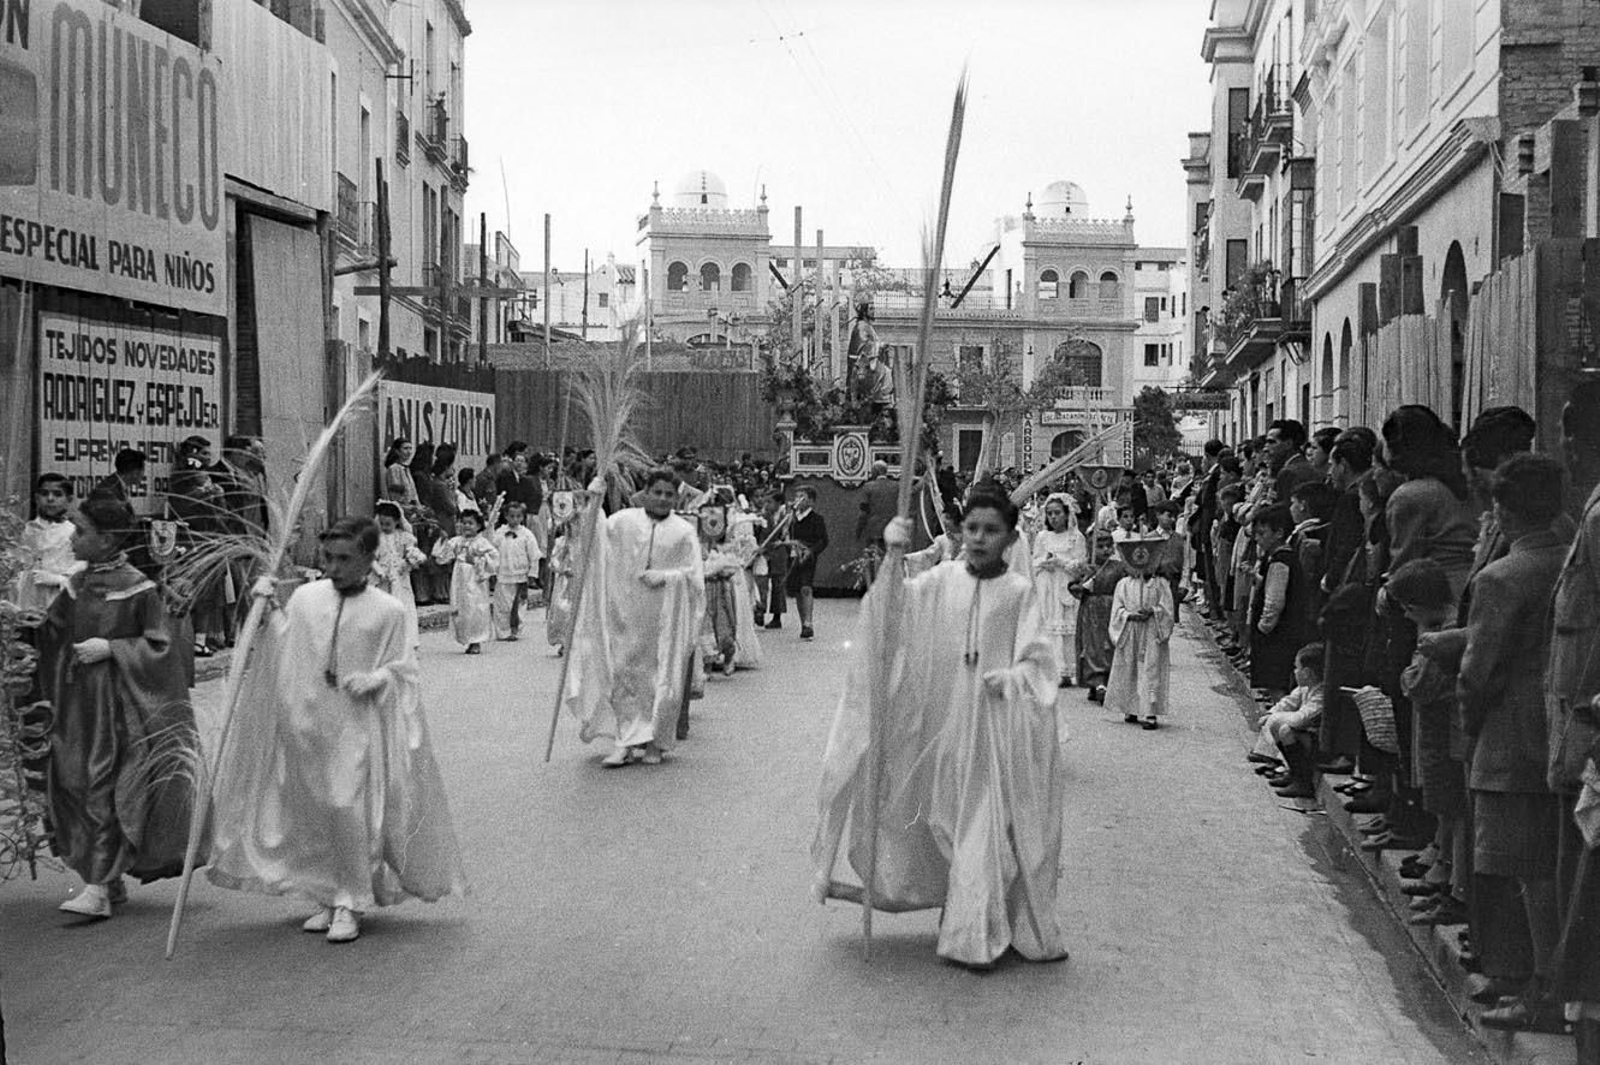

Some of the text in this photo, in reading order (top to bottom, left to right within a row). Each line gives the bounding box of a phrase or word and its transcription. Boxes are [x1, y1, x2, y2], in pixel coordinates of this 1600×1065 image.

[0, 214, 215, 293] ESPECIAL PARA NIÑOS
[46, 329, 216, 376] TEJIDOS NOVEDADES
[44, 372, 136, 424] RODRIGUEZ
[384, 397, 492, 456] ANIS ZURITO
